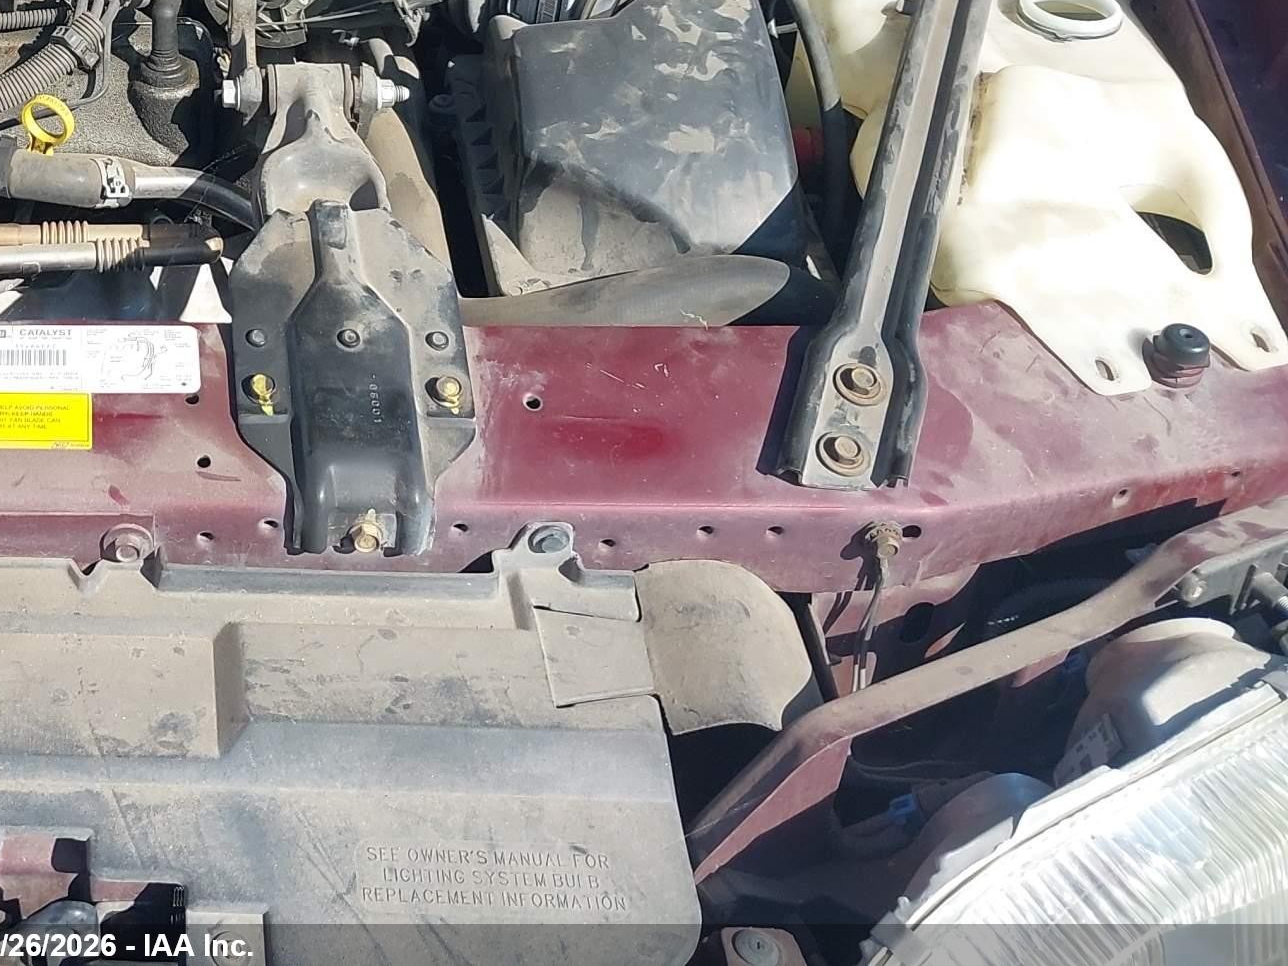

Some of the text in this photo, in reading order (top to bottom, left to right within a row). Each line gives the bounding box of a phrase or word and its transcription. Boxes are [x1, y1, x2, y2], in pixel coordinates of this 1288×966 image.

[19, 328, 73, 337] CATALYST
[366, 846, 610, 870] SEE OWNER'S MANUAL FOR
[382, 867, 600, 890] LIGHTING SYSTEM BULB
[361, 887, 628, 913] REPLACEMENT INFORMATION
